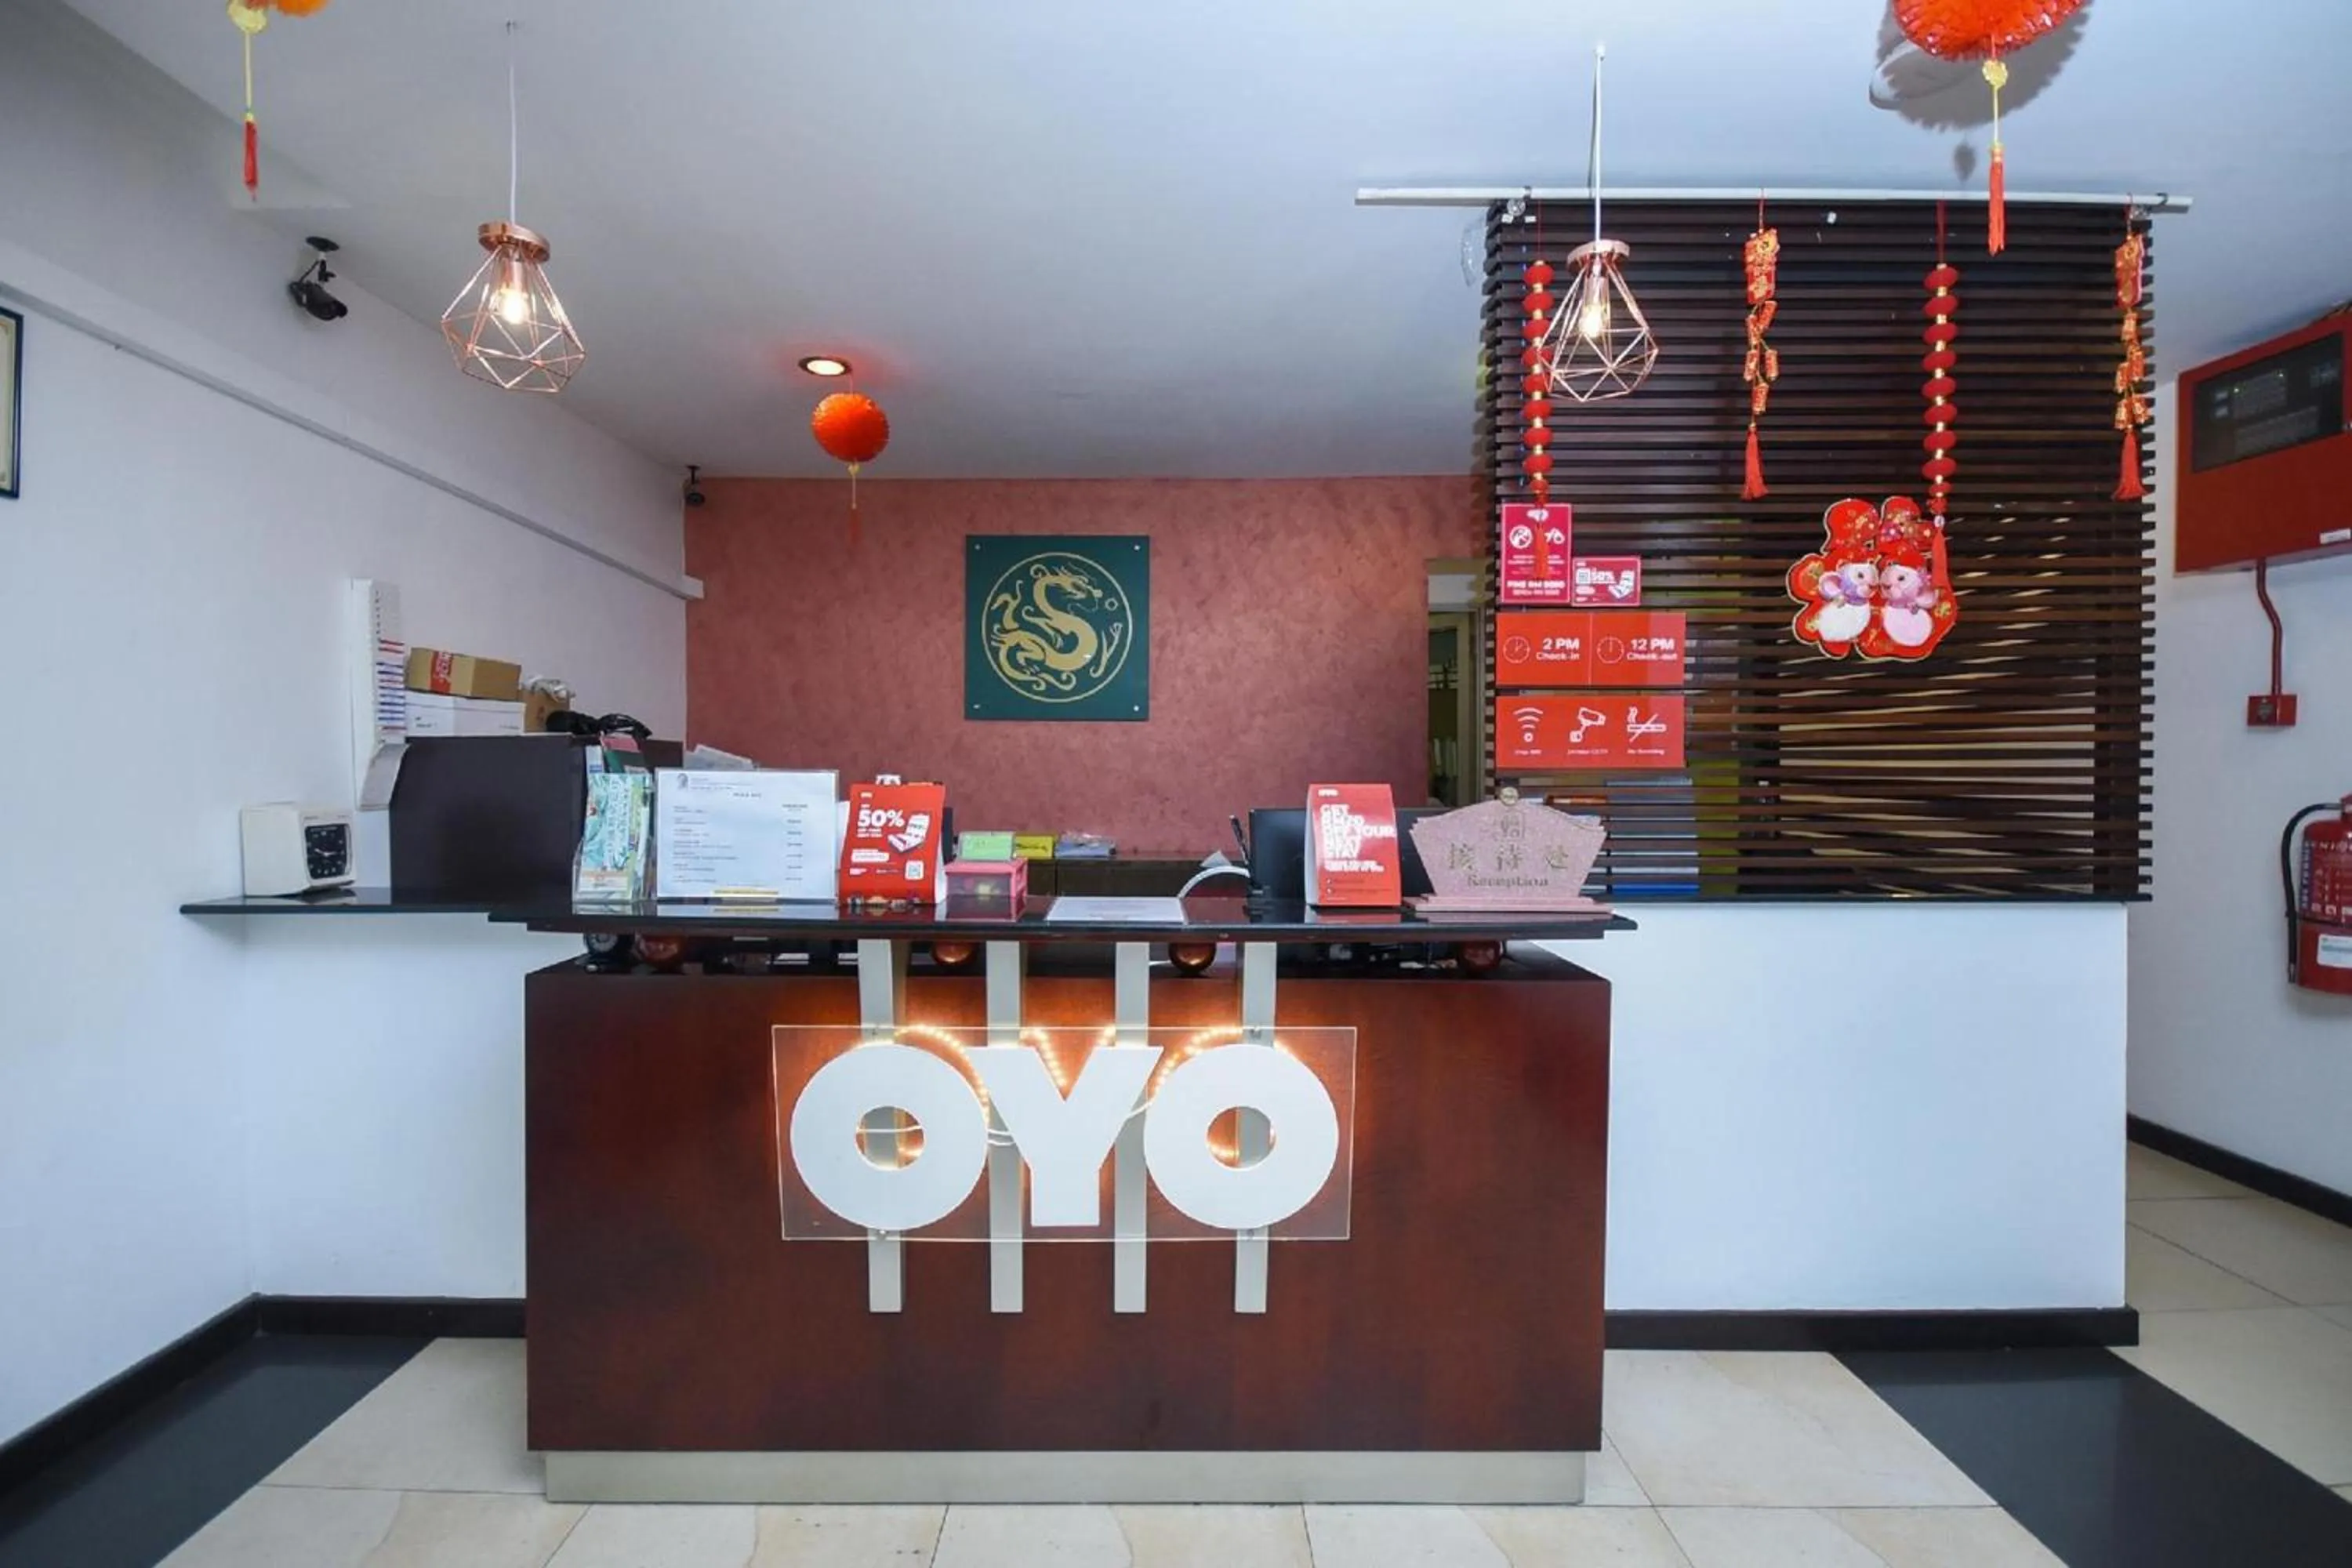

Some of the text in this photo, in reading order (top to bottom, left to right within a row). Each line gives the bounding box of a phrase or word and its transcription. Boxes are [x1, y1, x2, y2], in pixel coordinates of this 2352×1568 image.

[1543, 638, 1581, 650] 2 PM
[1631, 638, 1675, 650] 12 PM
[858, 809, 905, 827] 50%
[1468, 875, 1548, 887] Reception
[790, 1044, 1339, 1230] OYO
